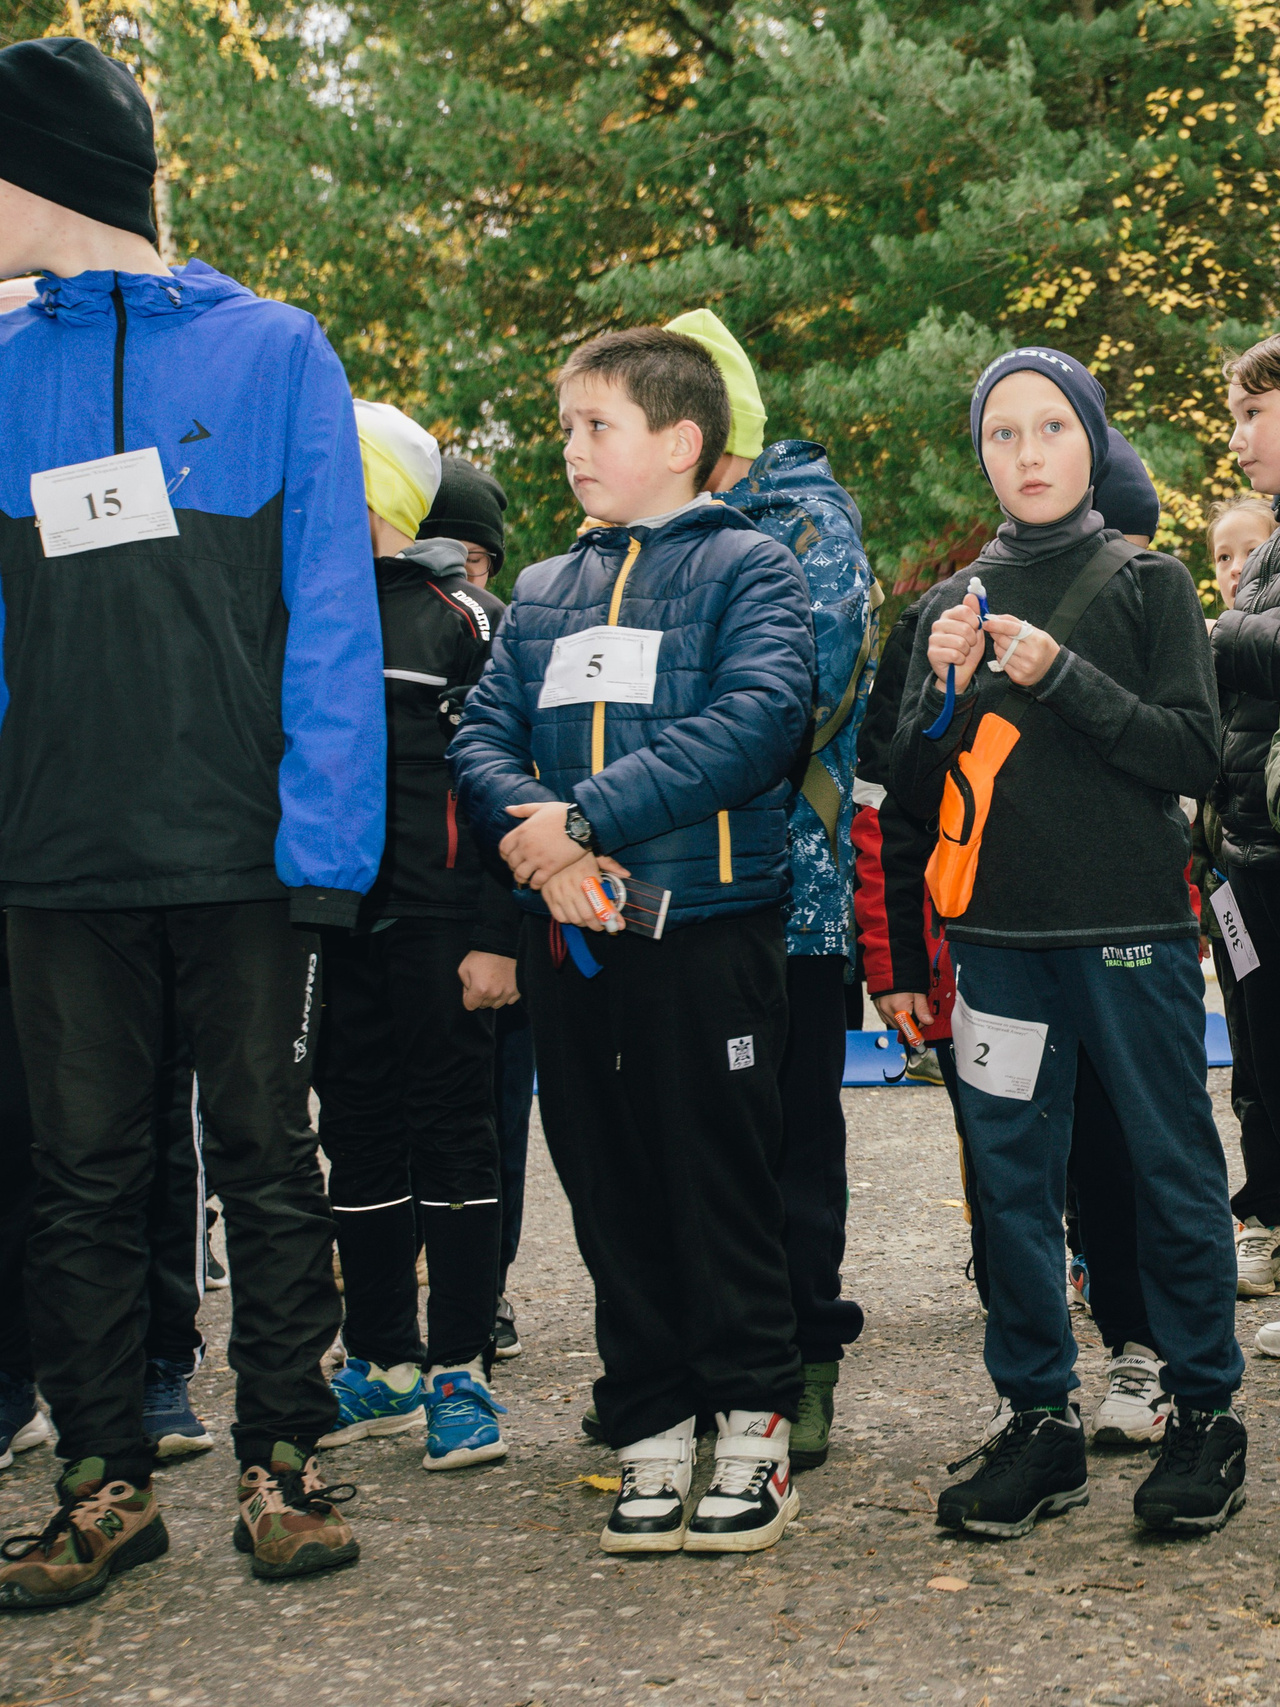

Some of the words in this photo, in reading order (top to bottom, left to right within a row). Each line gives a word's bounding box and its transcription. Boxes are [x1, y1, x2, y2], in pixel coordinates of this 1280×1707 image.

[82, 488, 122, 521] 15
[586, 653, 605, 678] 5
[1223, 910, 1244, 953] 308
[1102, 944, 1153, 961] ATHLETIC
[1136, 957, 1152, 967] FIELD
[973, 1042, 990, 1067] 2
